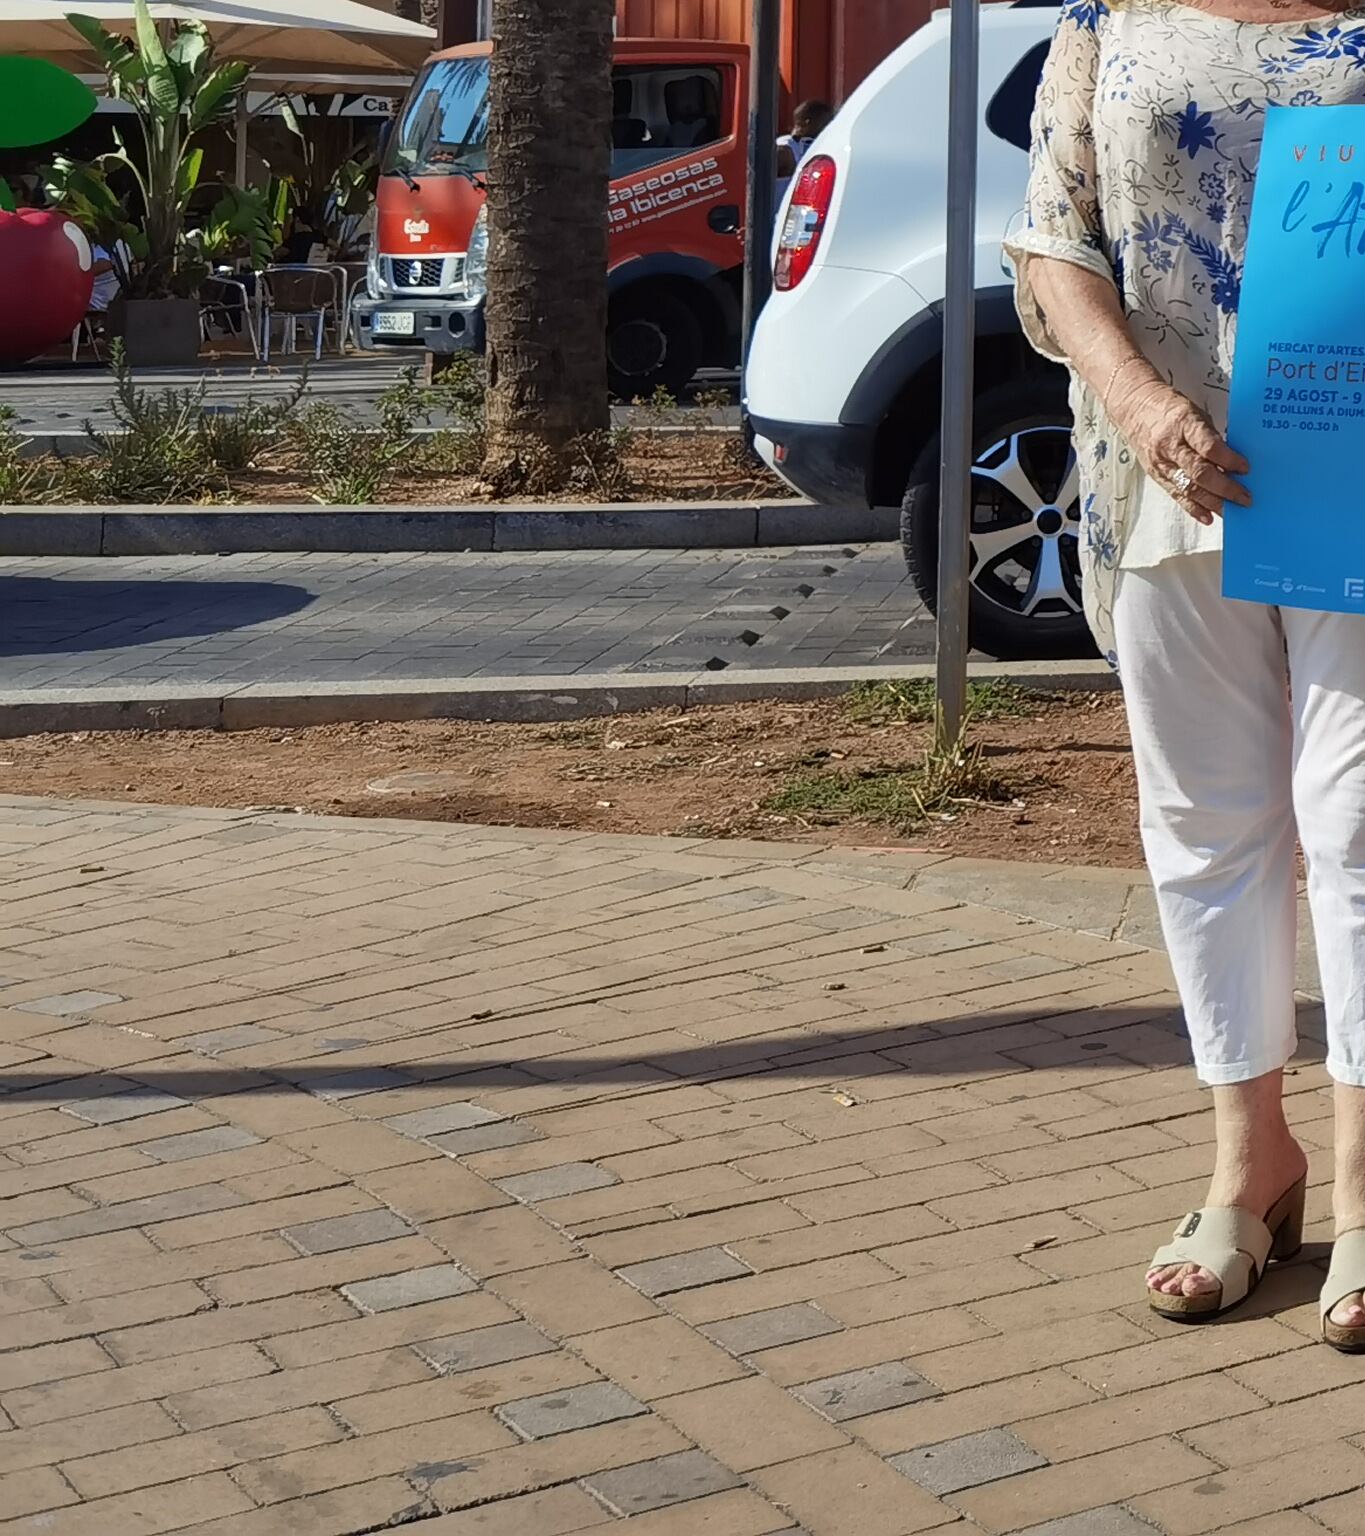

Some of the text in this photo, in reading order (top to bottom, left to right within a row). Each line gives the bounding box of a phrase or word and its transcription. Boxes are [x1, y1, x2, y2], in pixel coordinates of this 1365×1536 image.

[1293, 145, 1354, 163] VIU
[631, 174, 724, 214] Ibicenca
[1268, 342, 1314, 354] MERCAT
[1267, 358, 1316, 379] Port
[1264, 388, 1282, 400] 29
[1287, 389, 1339, 403] AGOST
[1353, 392, 1361, 404] 9
[1263, 404, 1277, 413] DE
[1280, 405, 1325, 416] DILLUNS
[1327, 407, 1334, 416] A
[1333, 422, 1339, 431] h
